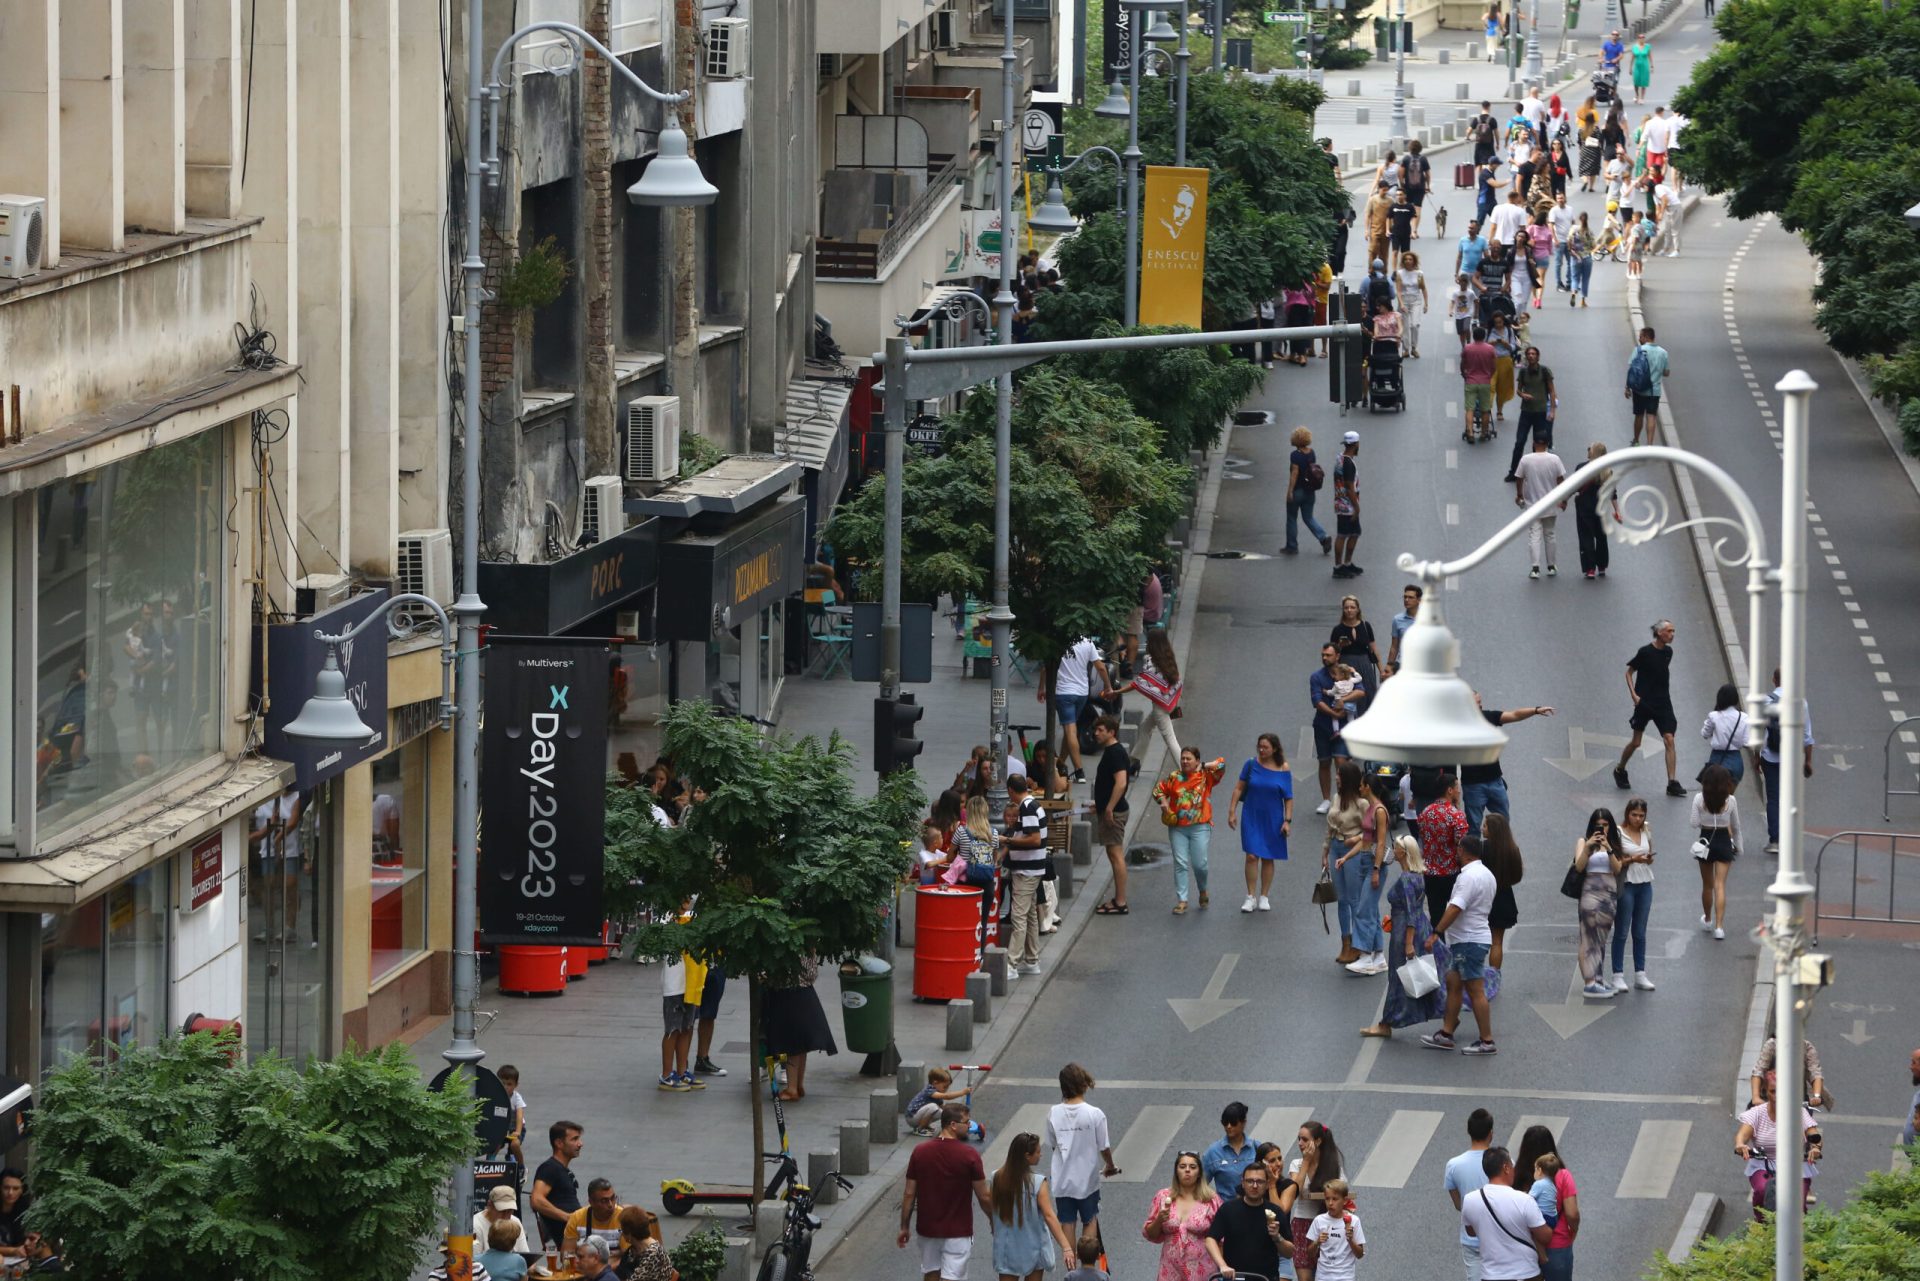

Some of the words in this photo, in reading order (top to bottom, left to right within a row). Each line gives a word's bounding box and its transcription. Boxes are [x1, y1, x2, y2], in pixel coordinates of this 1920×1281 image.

[1147, 249, 1200, 260] ENESCU
[1147, 261, 1199, 270] FESTIVAL
[591, 552, 624, 600] PORC
[516, 913, 535, 921] 19-21
[535, 913, 566, 922] October
[524, 924, 558, 933] xday.com
